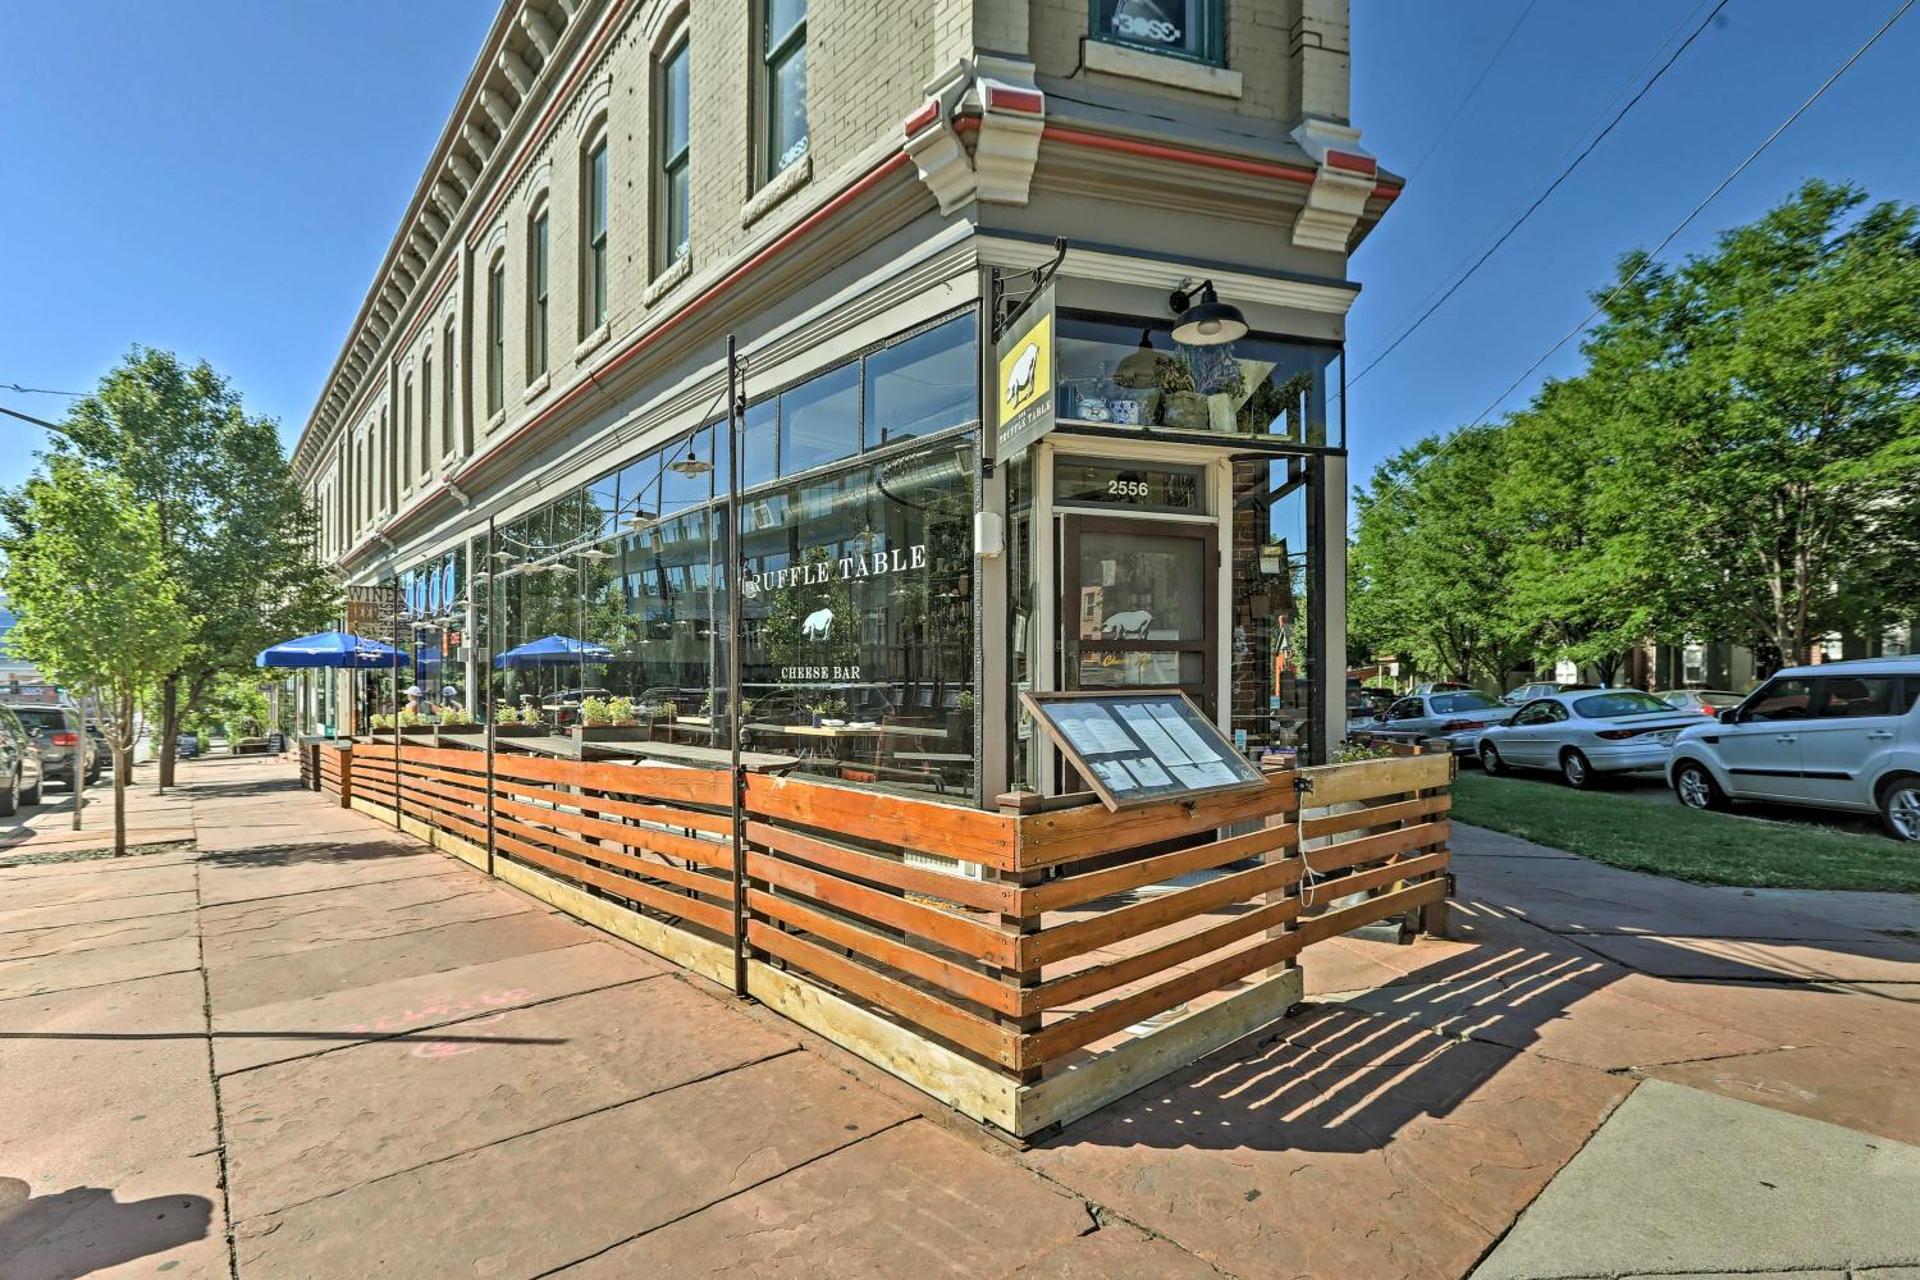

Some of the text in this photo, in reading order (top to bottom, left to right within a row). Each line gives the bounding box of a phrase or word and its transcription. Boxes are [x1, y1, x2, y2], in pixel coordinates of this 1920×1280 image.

[1027, 400, 1052, 423] TABLE
[1108, 480, 1149, 496] 2556
[839, 544, 926, 580] TABLE
[348, 585, 394, 602] WINE
[781, 666, 861, 680] CHEESE BAR
